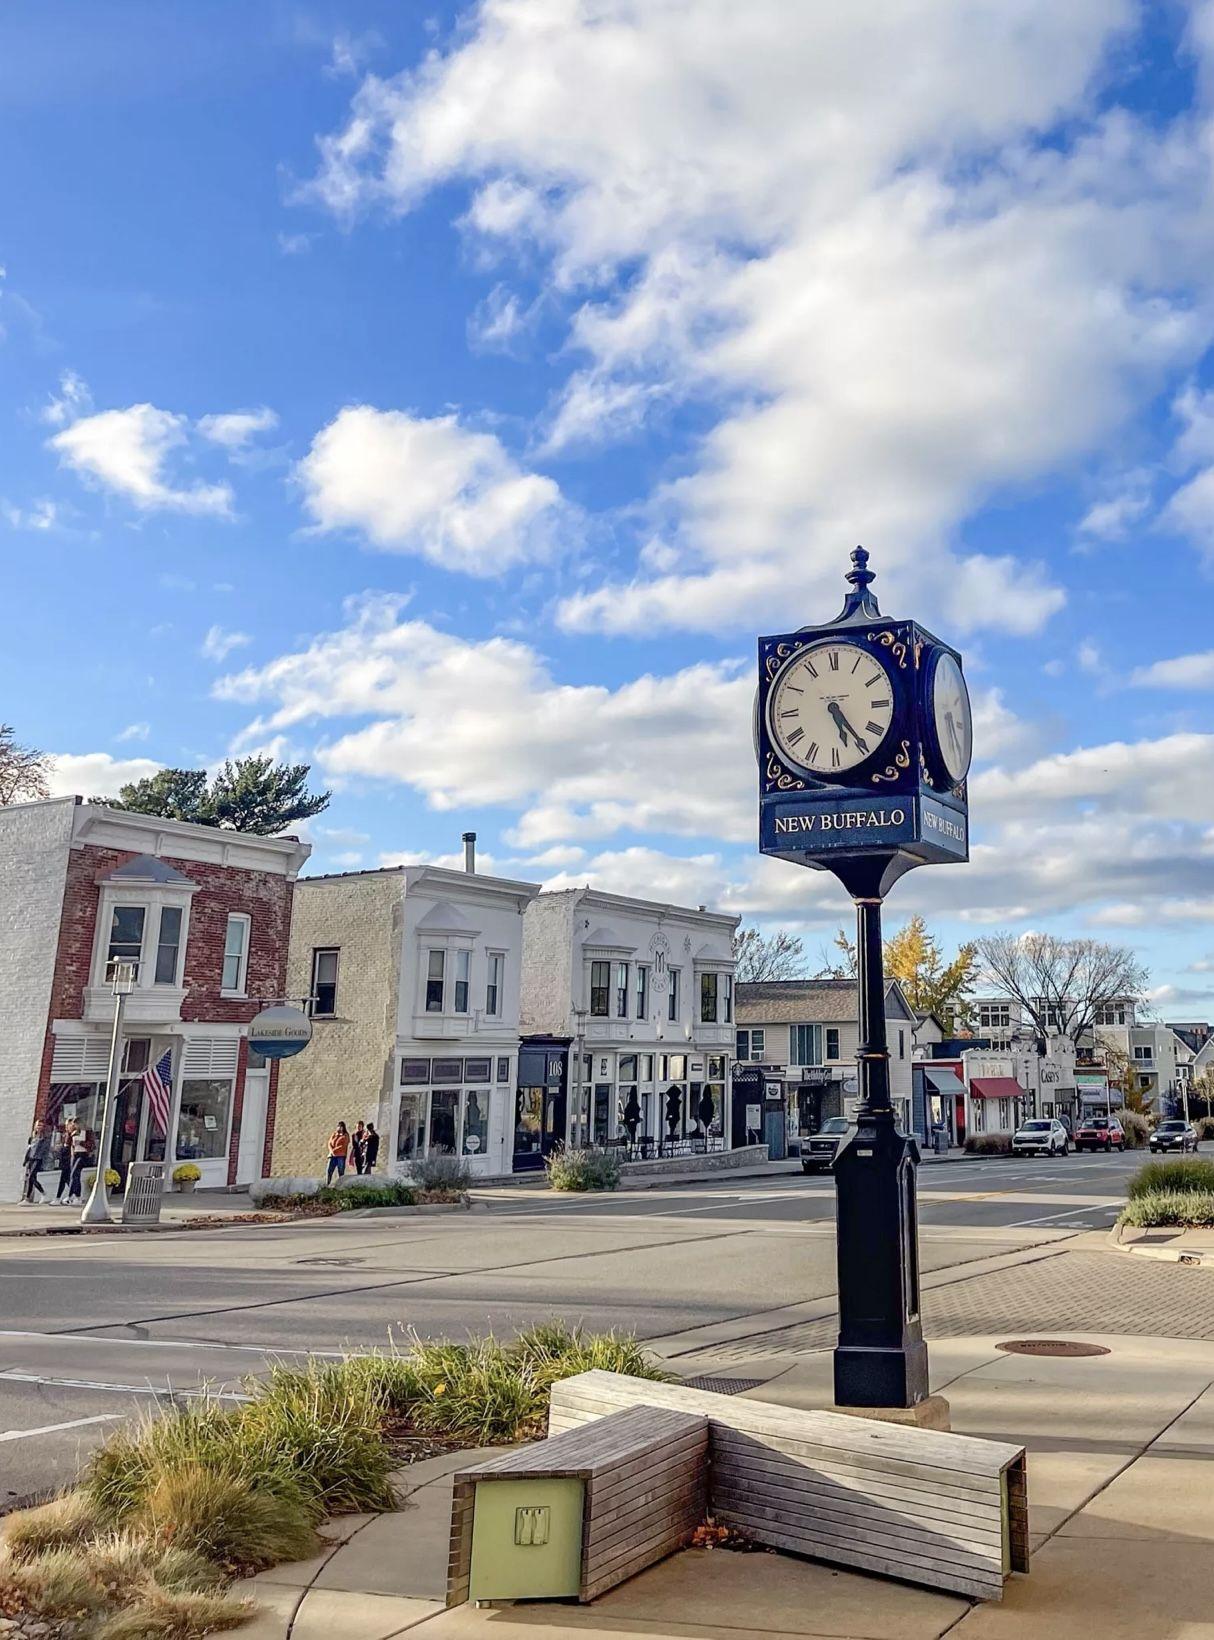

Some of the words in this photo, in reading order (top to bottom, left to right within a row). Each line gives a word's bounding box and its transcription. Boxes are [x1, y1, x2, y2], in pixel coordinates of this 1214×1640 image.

[774, 816, 816, 834] NEW
[820, 809, 905, 830] BUFFALO
[923, 810, 938, 830] NEW
[938, 817, 965, 842] BUFFALO
